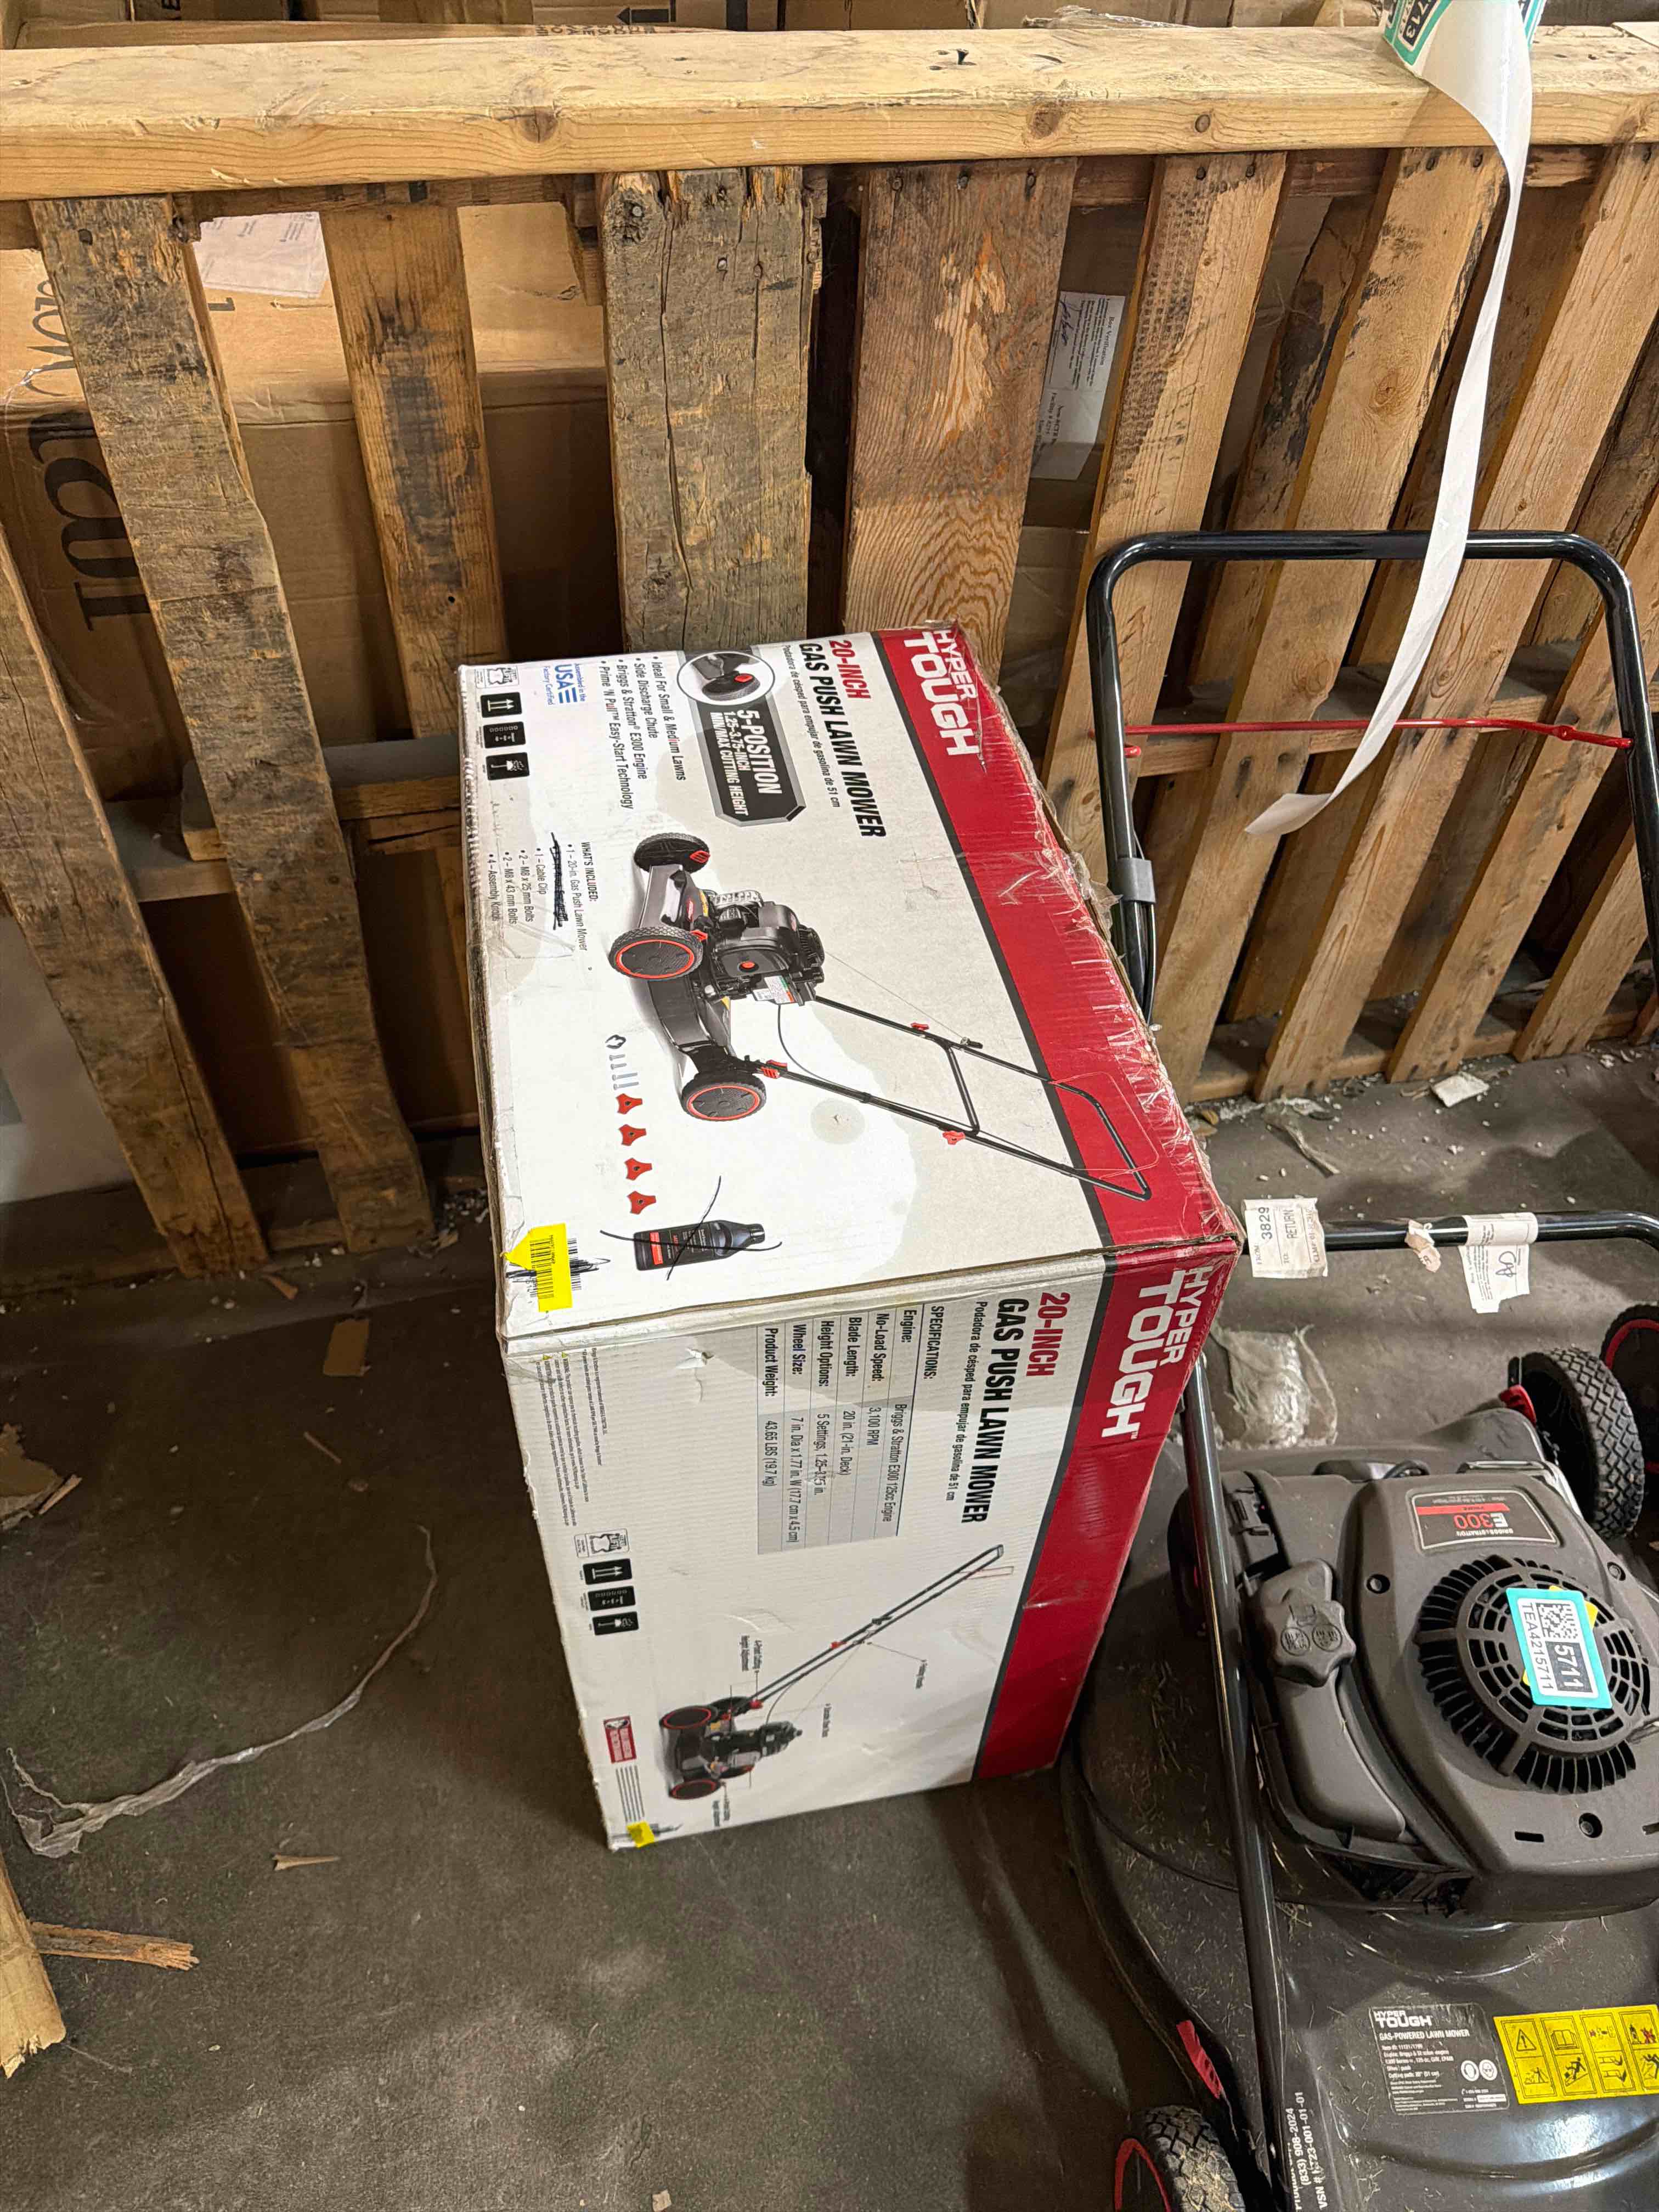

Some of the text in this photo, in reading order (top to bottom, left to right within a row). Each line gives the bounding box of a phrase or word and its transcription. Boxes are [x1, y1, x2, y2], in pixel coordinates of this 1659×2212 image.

[1099, 329, 1113, 366] Verification
[575, 663, 585, 687] Assembled
[616, 664, 629, 687] Briggs
[651, 662, 665, 679] Ideal
[828, 639, 871, 699] 20-INCH
[933, 630, 978, 699] HYPER
[543, 666, 555, 706] Factory Certified
[555, 664, 574, 690] USA
[599, 666, 612, 687] Prime
[655, 680, 667, 692] For
[792, 679, 808, 699] césped
[903, 630, 979, 756] TOUGH
[634, 663, 659, 738] Side Discharge Chute
[658, 693, 674, 714] Small
[797, 701, 810, 714] para
[665, 723, 680, 753] Medium
[804, 715, 819, 740] empujar
[608, 723, 627, 762] Easy-Start
[629, 732, 644, 751] E300
[798, 642, 887, 838] GAS PUSH LAWN MOWER
[812, 741, 823, 749] de
[736, 709, 783, 794] 5-POSITION
[633, 753, 648, 780] Engine
[672, 755, 686, 781] Lawns
[710, 712, 749, 816] MIN/MAX CUTTING HEIGHT
[812, 750, 831, 776] gasolina
[617, 764, 634, 809] Technology
[823, 777, 834, 786] de
[827, 787, 839, 795] 51
[830, 797, 840, 808] cm
[504, 868, 514, 878] M8
[520, 866, 531, 876] M8
[535, 864, 546, 882] Cable
[567, 860, 578, 878] 20-in.
[581, 842, 599, 902] WHAT'S INCLUDED:
[488, 871, 500, 901] Assembly
[505, 884, 516, 893] 43
[522, 882, 532, 891] 25
[537, 883, 549, 895] Clip
[570, 879, 580, 891] Gas
[506, 894, 518, 907] mm
[522, 891, 532, 905] mm
[572, 893, 583, 908] Push
[507, 908, 520, 926] Bolts
[523, 905, 535, 922] Bolts
[574, 909, 584, 928] Lawn
[577, 928, 588, 951] Mower
[1258, 1206, 1273, 1240] 3829
[1284, 1209, 1298, 1239] RETURN
[899, 1309, 918, 1343] Engine:
[970, 1301, 988, 1341] Podadora
[1159, 1268, 1213, 1365] HYPER
[792, 1324, 807, 1352] Wheel
[818, 1321, 835, 1350] Height
[923, 1306, 945, 1379] SPECIFICATIONS:
[1025, 1292, 1071, 1377] 20-INCH
[969, 1342, 981, 1353] de
[792, 1353, 806, 1375] Size:
[817, 1352, 833, 1387] Options:
[963, 1355, 979, 1382] césped
[866, 1313, 890, 1446] No-Load Speed: 3,100 RPM
[837, 1317, 862, 1476] Blade Length: 20 in. (21-in. Deck)
[961, 1384, 973, 1401] para
[762, 1328, 779, 1487] Product Weight: 43.65 LBS (19.7 kg)
[890, 1404, 908, 1427] Briggs
[955, 1402, 970, 1432] empujar
[961, 1298, 1030, 1523] GAS PUSH LAWN MOWER
[791, 1424, 804, 1433] in.
[813, 1420, 830, 1452] Settings,
[955, 1434, 967, 1443] de
[790, 1435, 804, 1447] Dia
[889, 1436, 904, 1463] Stratton
[790, 1454, 803, 1469] 1.77
[951, 1444, 963, 1472] gasolina
[789, 1470, 803, 1481] in.
[887, 1464, 901, 1481] E300
[949, 1473, 961, 1481] de
[787, 1487, 802, 1504] (17.7
[814, 1487, 826, 1496] in.
[884, 1482, 899, 1501] 125cc
[946, 1491, 955, 1501] cm
[789, 1505, 799, 1515] cm
[881, 1502, 896, 1522] Engine
[788, 1521, 800, 1531] 4.5
[1454, 1513, 1508, 1530] E300
[787, 1531, 799, 1543] cm)
[1522, 1602, 1554, 1689] TEA4215711
[1554, 1644, 1584, 1688] 5711
[1374, 2010, 1406, 2019] HYPER
[1375, 2016, 1432, 2028] TOUGH
[1379, 2032, 1425, 2041] GAS-POWERED
[1425, 2031, 1445, 2039] LAWN
[1285, 2108, 1304, 2157] 908-2024
[1296, 2158, 1312, 2185] (833)
[1315, 2186, 1328, 2209] VSN
